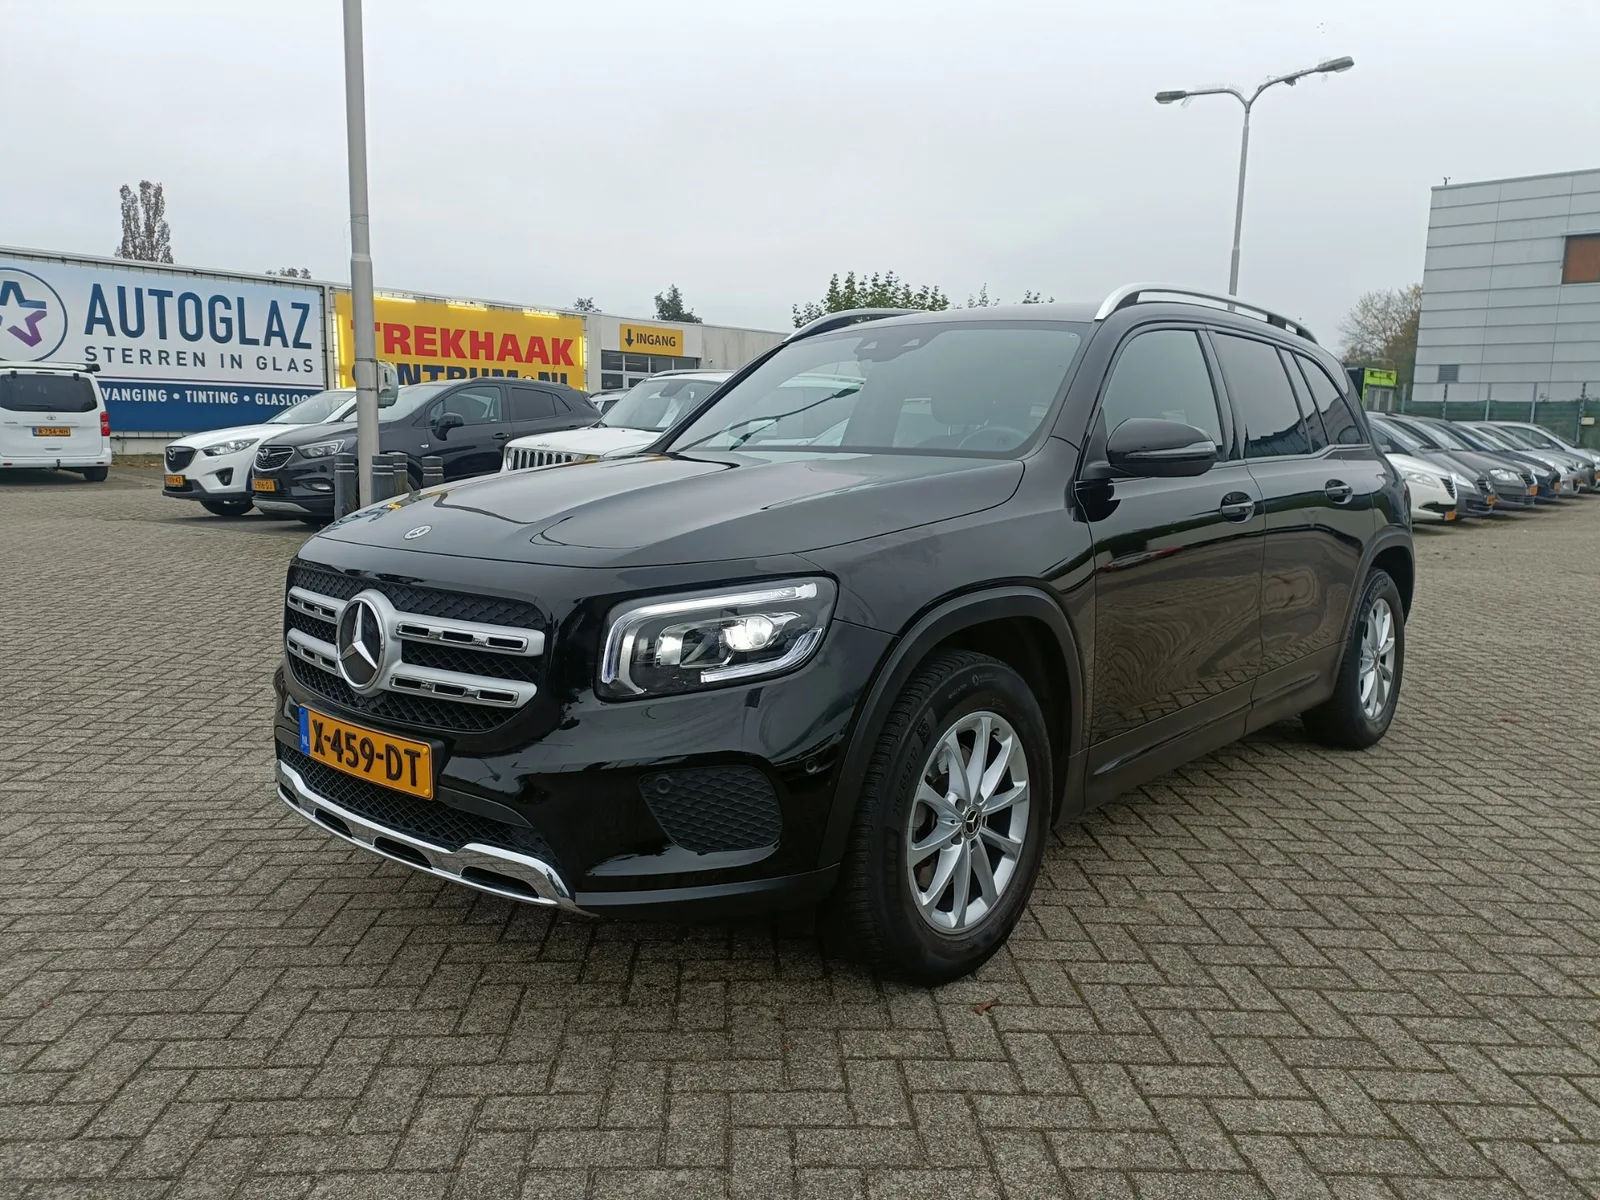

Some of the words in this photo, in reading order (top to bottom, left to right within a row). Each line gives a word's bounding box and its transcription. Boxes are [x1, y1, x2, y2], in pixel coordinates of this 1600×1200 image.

[84, 283, 312, 349] AUTOGLAZ
[84, 345, 206, 368] STERREN
[220, 353, 243, 370] IN
[256, 355, 313, 373] GLAS
[351, 319, 574, 367] REKHAAK
[636, 333, 676, 347] INGANG
[185, 390, 238, 404] TINTING
[312, 719, 421, 787] X-459-DT
